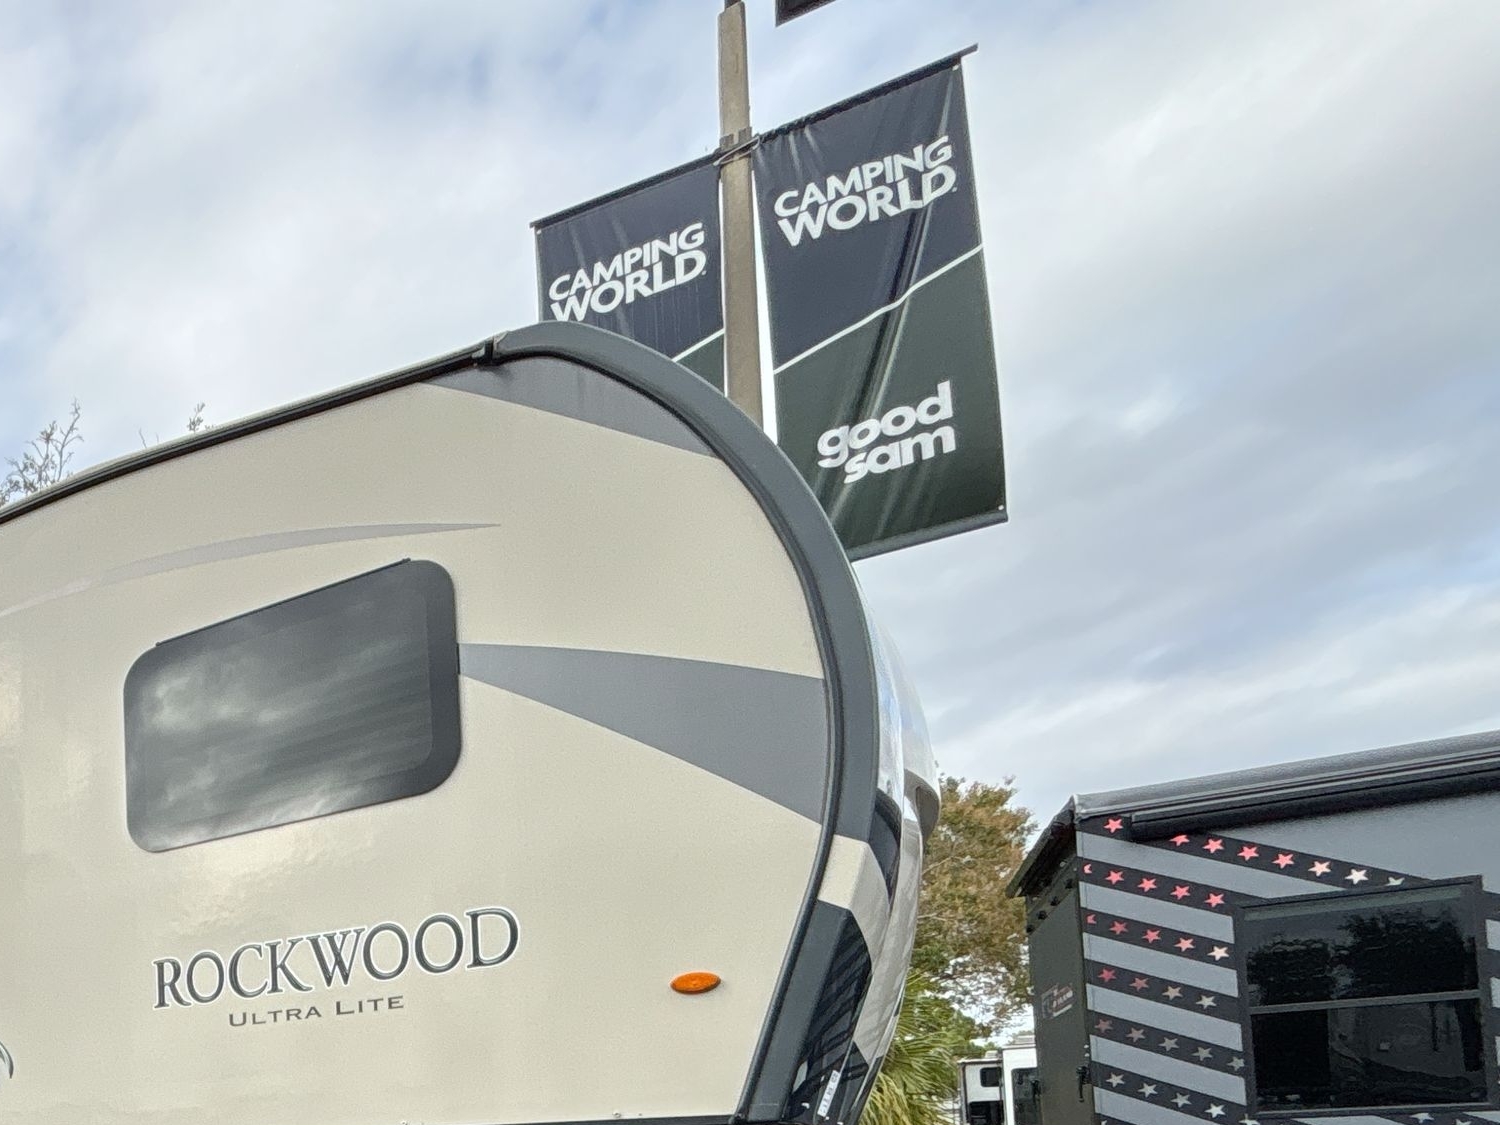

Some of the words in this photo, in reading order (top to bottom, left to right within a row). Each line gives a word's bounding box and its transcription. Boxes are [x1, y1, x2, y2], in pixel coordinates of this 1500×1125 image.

[774, 134, 952, 218] CAMPING
[776, 165, 956, 248] WORLD
[548, 222, 705, 301] CAMPING
[550, 249, 707, 322] WORLD
[817, 380, 953, 468] good
[844, 425, 956, 484] sam
[152, 906, 521, 1011] ROCKWOOD
